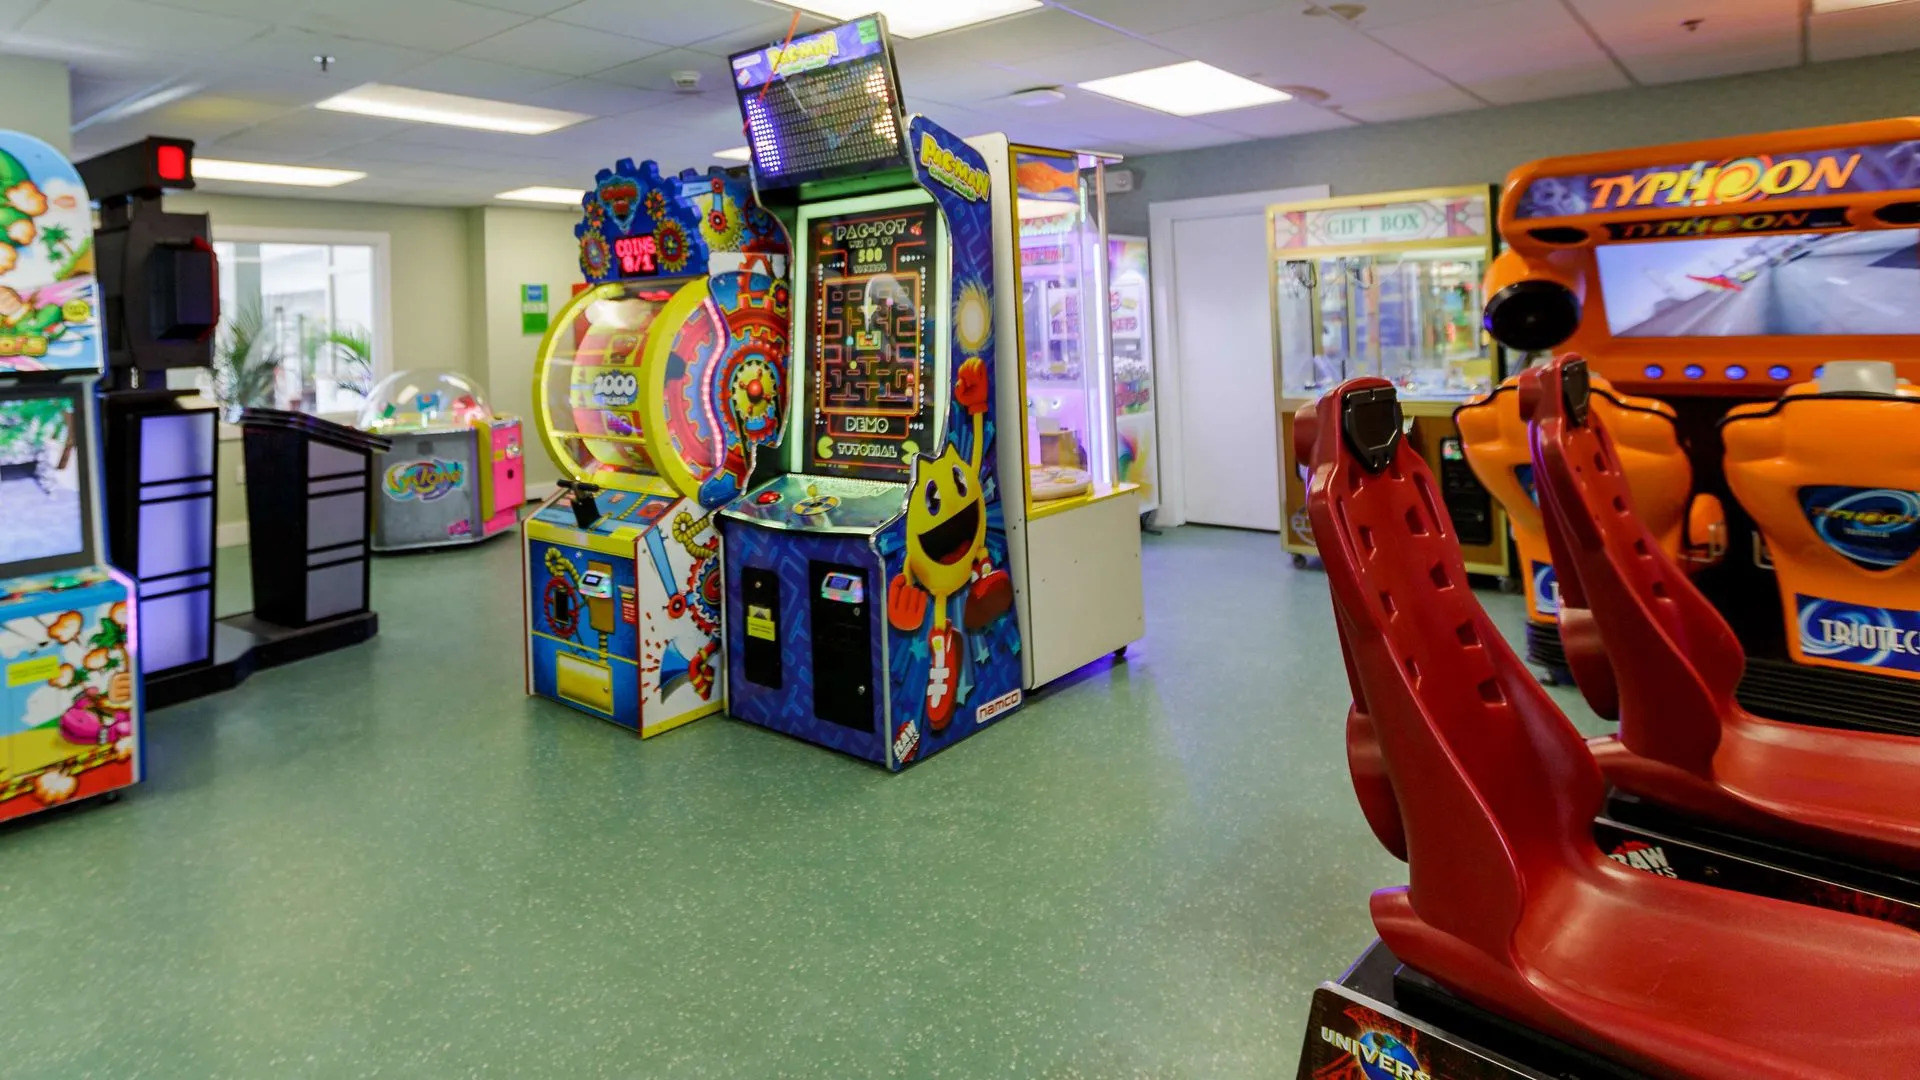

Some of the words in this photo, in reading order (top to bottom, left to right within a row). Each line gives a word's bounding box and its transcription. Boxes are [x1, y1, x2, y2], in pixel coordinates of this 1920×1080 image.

[921, 132, 991, 201] PAC-MAN
[1590, 153, 1861, 209] TYPHOON
[836, 218, 907, 241] PAC-POT
[1327, 217, 1371, 236] GIFT
[1380, 213, 1419, 233] BOX
[1622, 212, 1810, 239] TYPHOON
[615, 235, 657, 257] COINS
[858, 247, 883, 263] 500
[622, 254, 655, 273] 0/1
[845, 416, 889, 434] DEMO
[837, 442, 898, 458] TUTORIAL
[979, 693, 1019, 719] namco
